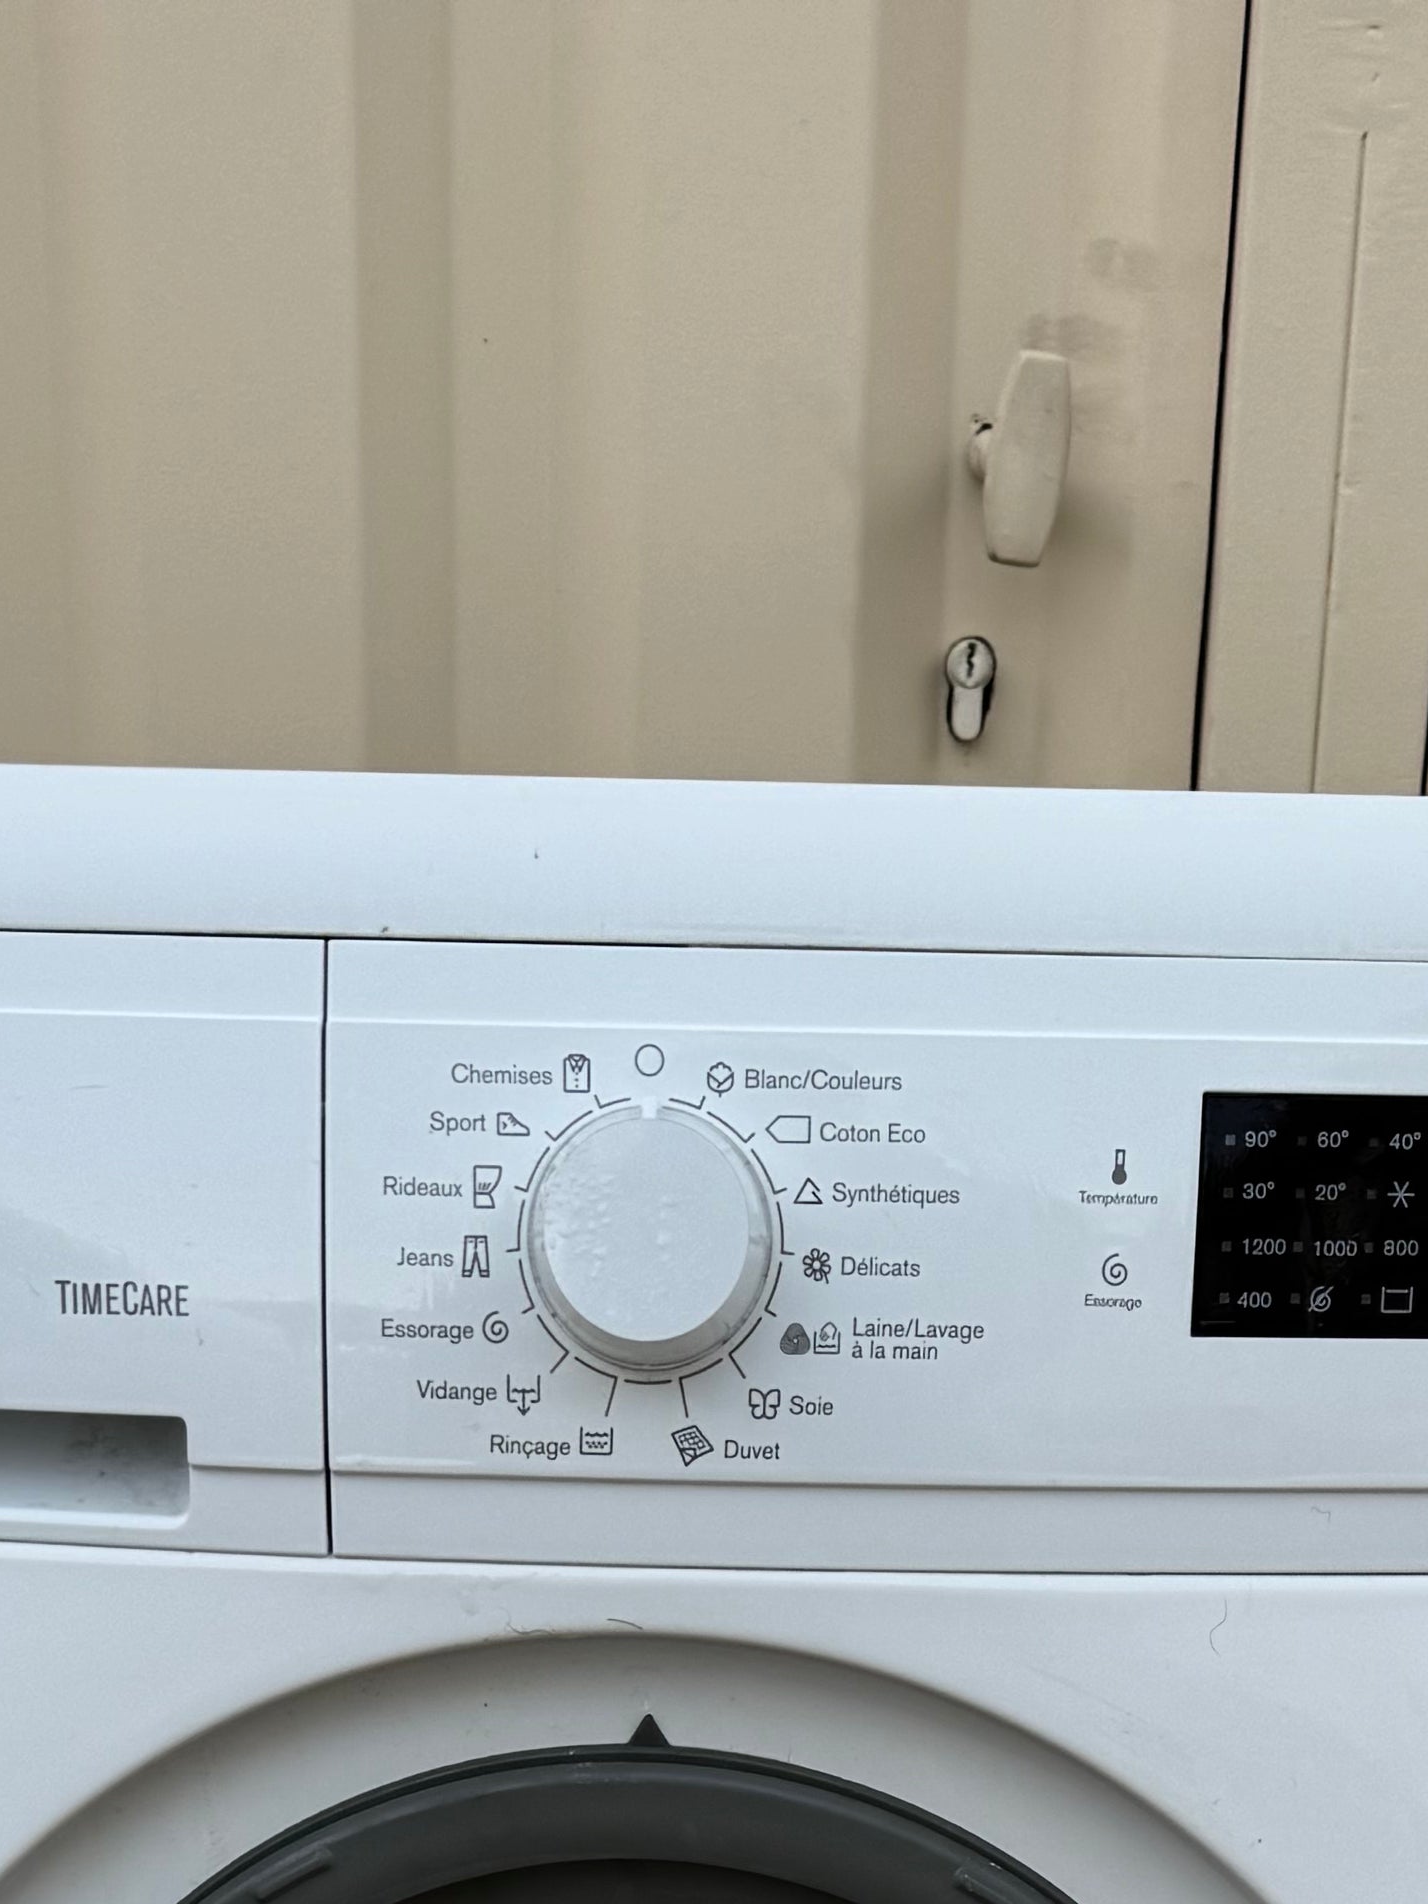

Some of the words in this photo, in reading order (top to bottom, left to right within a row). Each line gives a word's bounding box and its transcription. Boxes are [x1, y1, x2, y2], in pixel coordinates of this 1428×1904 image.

[451, 1064, 553, 1087] Chemises
[745, 1069, 902, 1091] Blanc/Couleurs
[430, 1112, 486, 1136] Sport
[820, 1123, 880, 1144] Coton
[888, 1124, 925, 1144] Eco
[383, 1177, 463, 1198] Rideaux
[832, 1182, 960, 1207] Synthétiques
[1079, 1190, 1158, 1206] Température
[1242, 1239, 1286, 1255] 1200
[1313, 1240, 1357, 1256] 1000
[1383, 1240, 1419, 1256] 800
[397, 1247, 454, 1269] Jeans
[840, 1256, 920, 1278] Délicats
[1084, 1294, 1142, 1311] Essorage
[1237, 1292, 1272, 1308] 400
[381, 1320, 474, 1343] Essorage
[852, 1319, 984, 1344] Laine/Lavage
[852, 1341, 862, 1360] à
[869, 1341, 884, 1360] la
[892, 1343, 938, 1360] main
[417, 1380, 498, 1405] Vidange
[789, 1396, 833, 1416] Soie
[489, 1435, 571, 1461] Rinçage
[724, 1440, 780, 1460] Duvet
